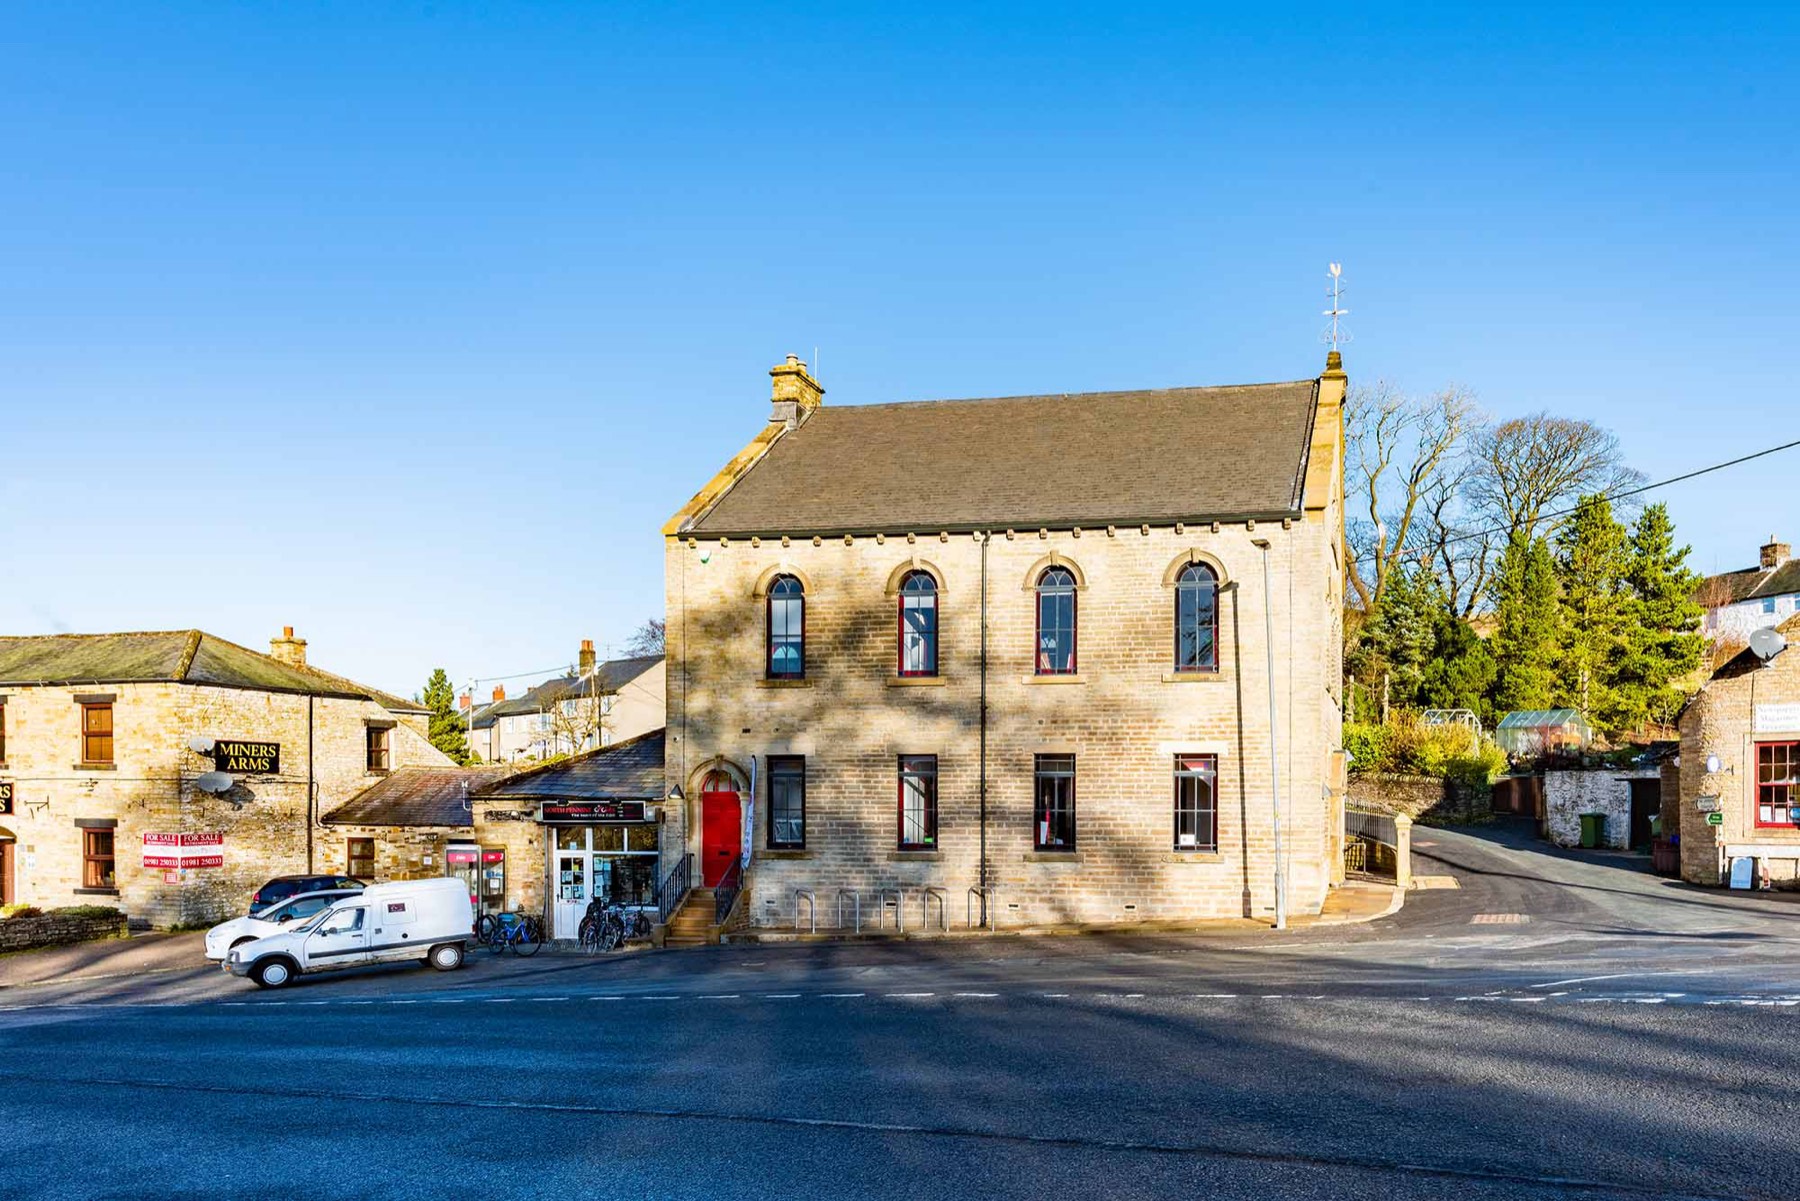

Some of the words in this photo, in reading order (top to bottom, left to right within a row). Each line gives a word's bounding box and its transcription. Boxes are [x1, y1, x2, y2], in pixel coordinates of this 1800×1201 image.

[220, 743, 276, 758] MINERS
[227, 757, 270, 771] ARMS
[146, 834, 159, 842] FOR
[159, 834, 176, 842] SALE
